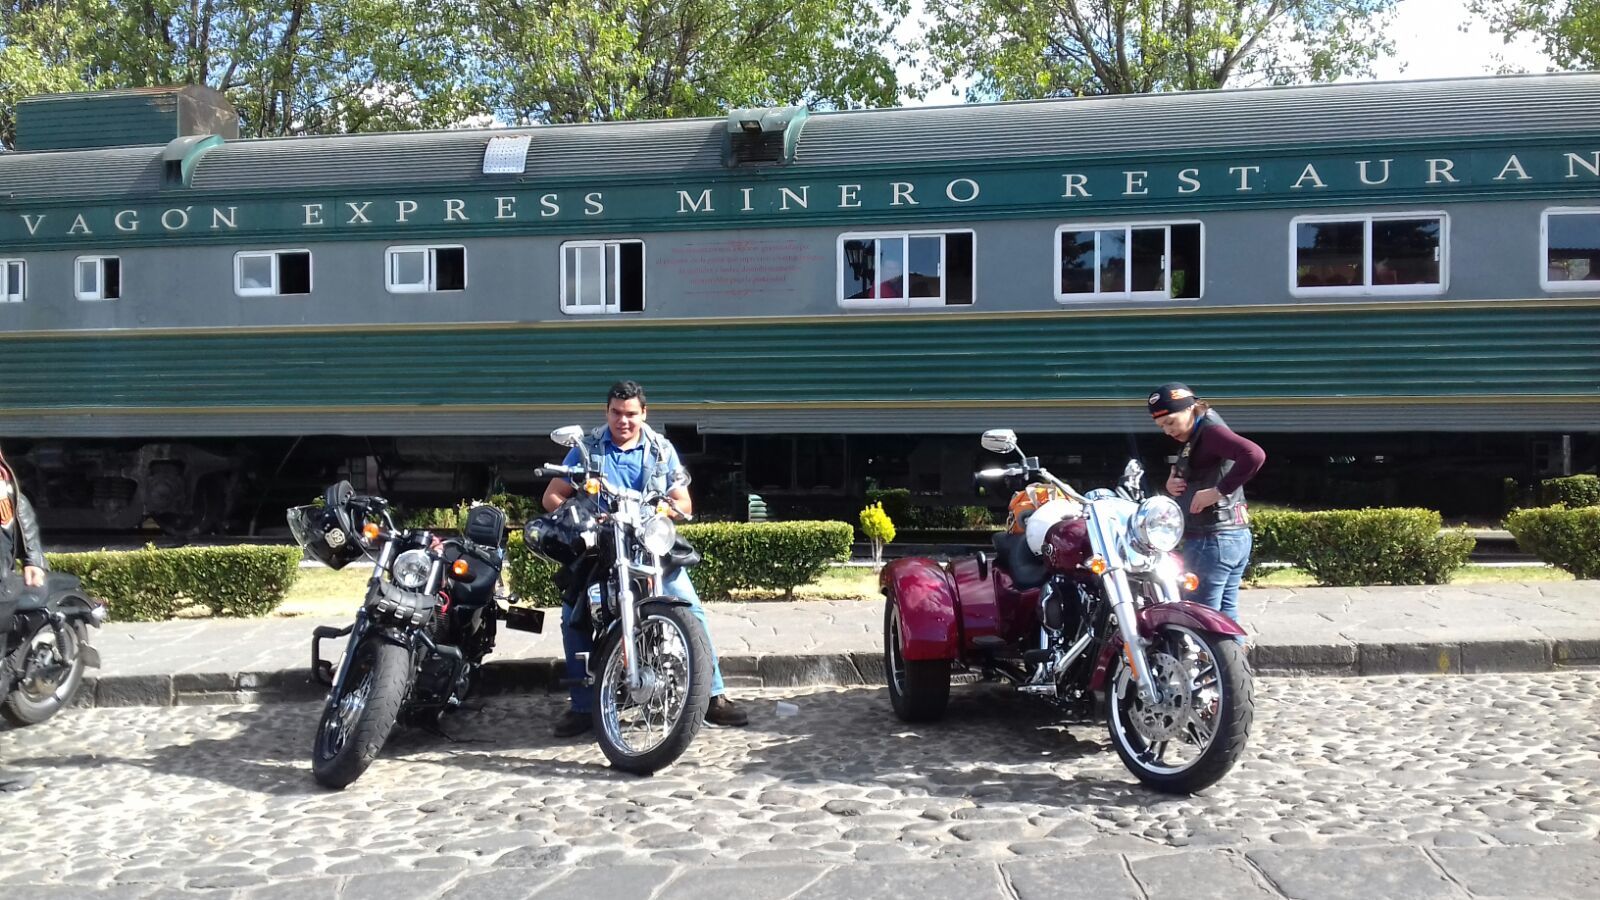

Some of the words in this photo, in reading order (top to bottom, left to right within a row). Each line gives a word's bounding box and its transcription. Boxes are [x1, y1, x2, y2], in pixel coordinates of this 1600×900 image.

[21, 205, 238, 236] VAGÓN
[301, 191, 605, 226] EXPRESS
[676, 178, 981, 213] MINERO
[1061, 150, 1600, 198] RESTAURAN
